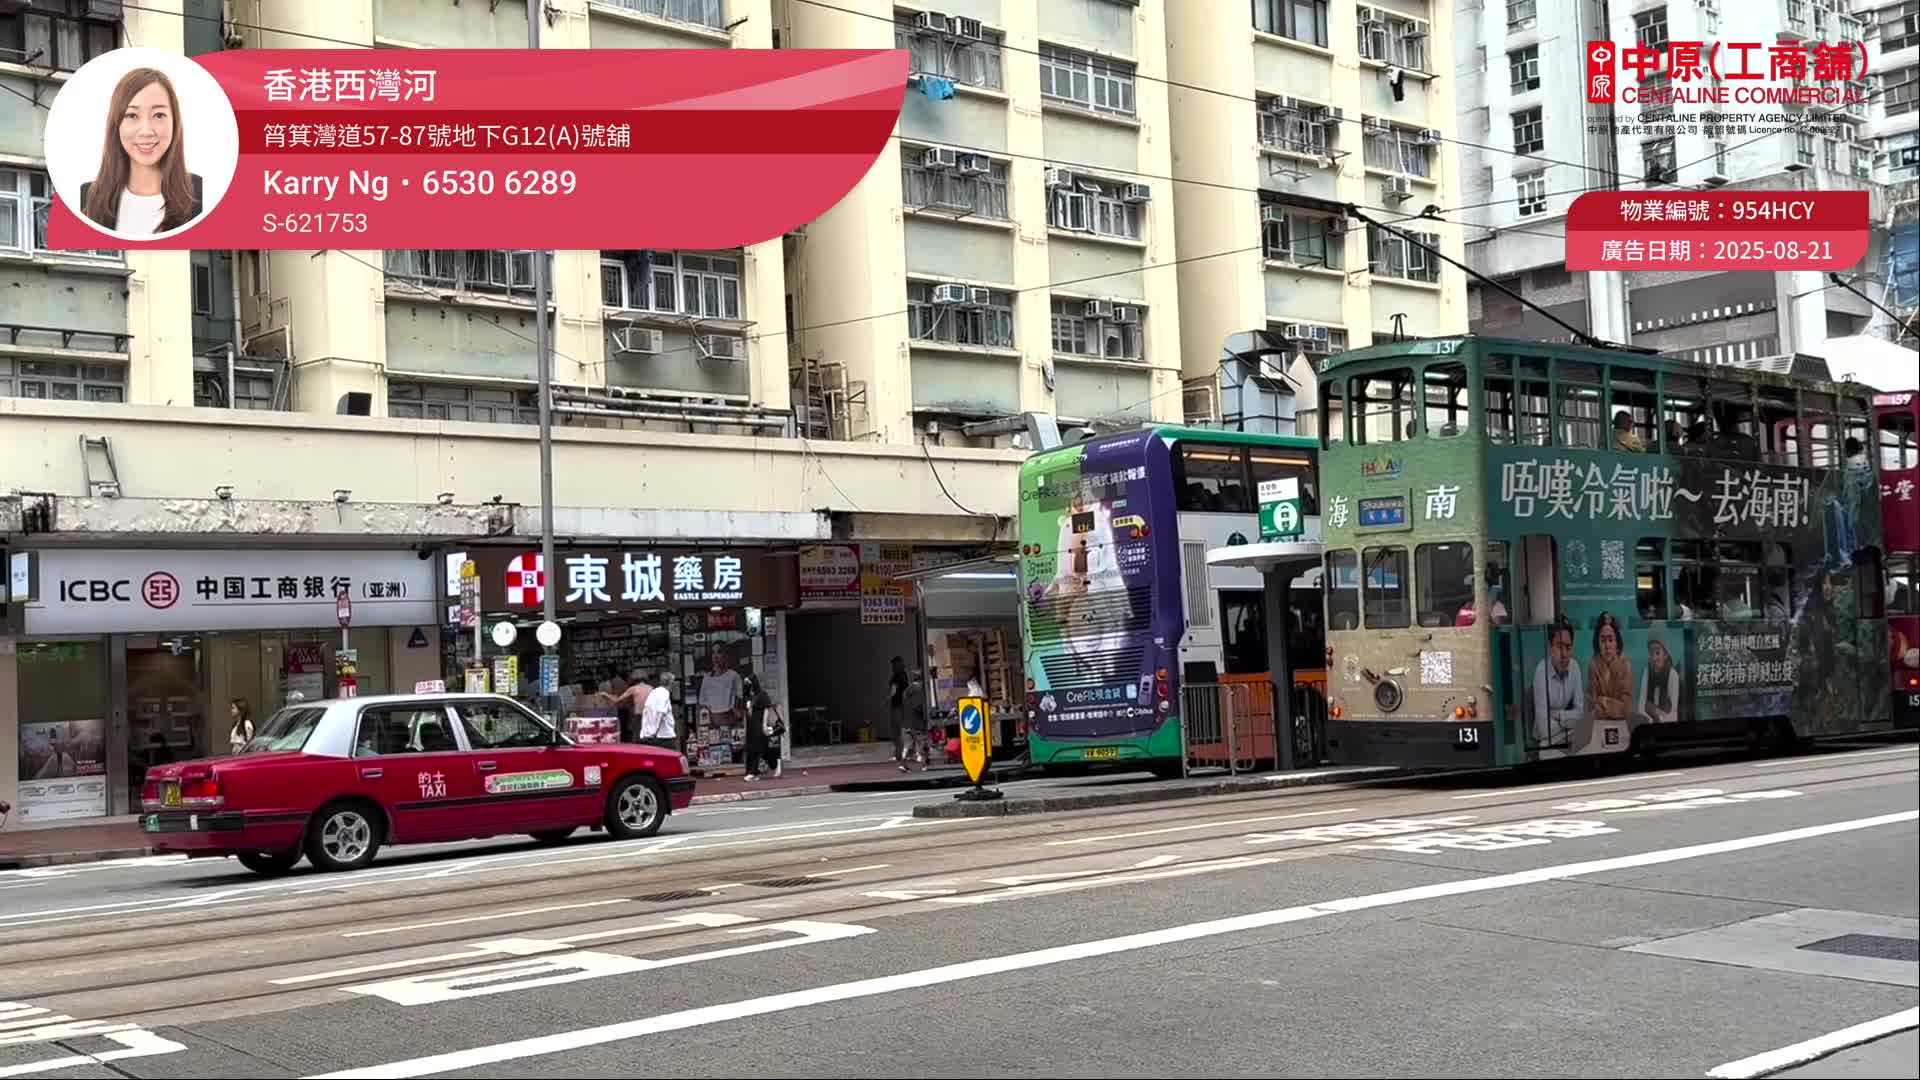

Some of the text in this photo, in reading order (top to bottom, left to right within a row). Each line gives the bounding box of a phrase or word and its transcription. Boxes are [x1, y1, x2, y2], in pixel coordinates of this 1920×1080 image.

[1436, 341, 1456, 354] 131
[1892, 393, 1912, 405] 159
[1328, 496, 1349, 528] 海
[1424, 485, 1461, 520] 南
[565, 553, 743, 602] 東城藥房
[60, 580, 131, 602] ICBC
[196, 576, 408, 600] 中国工商银行 (亚洲)
[702, 592, 743, 600] DISPENSARY
[1909, 694, 1920, 706] 15
[1459, 728, 1478, 743] 131
[418, 771, 446, 784] 的士
[419, 784, 446, 798] TAXI
